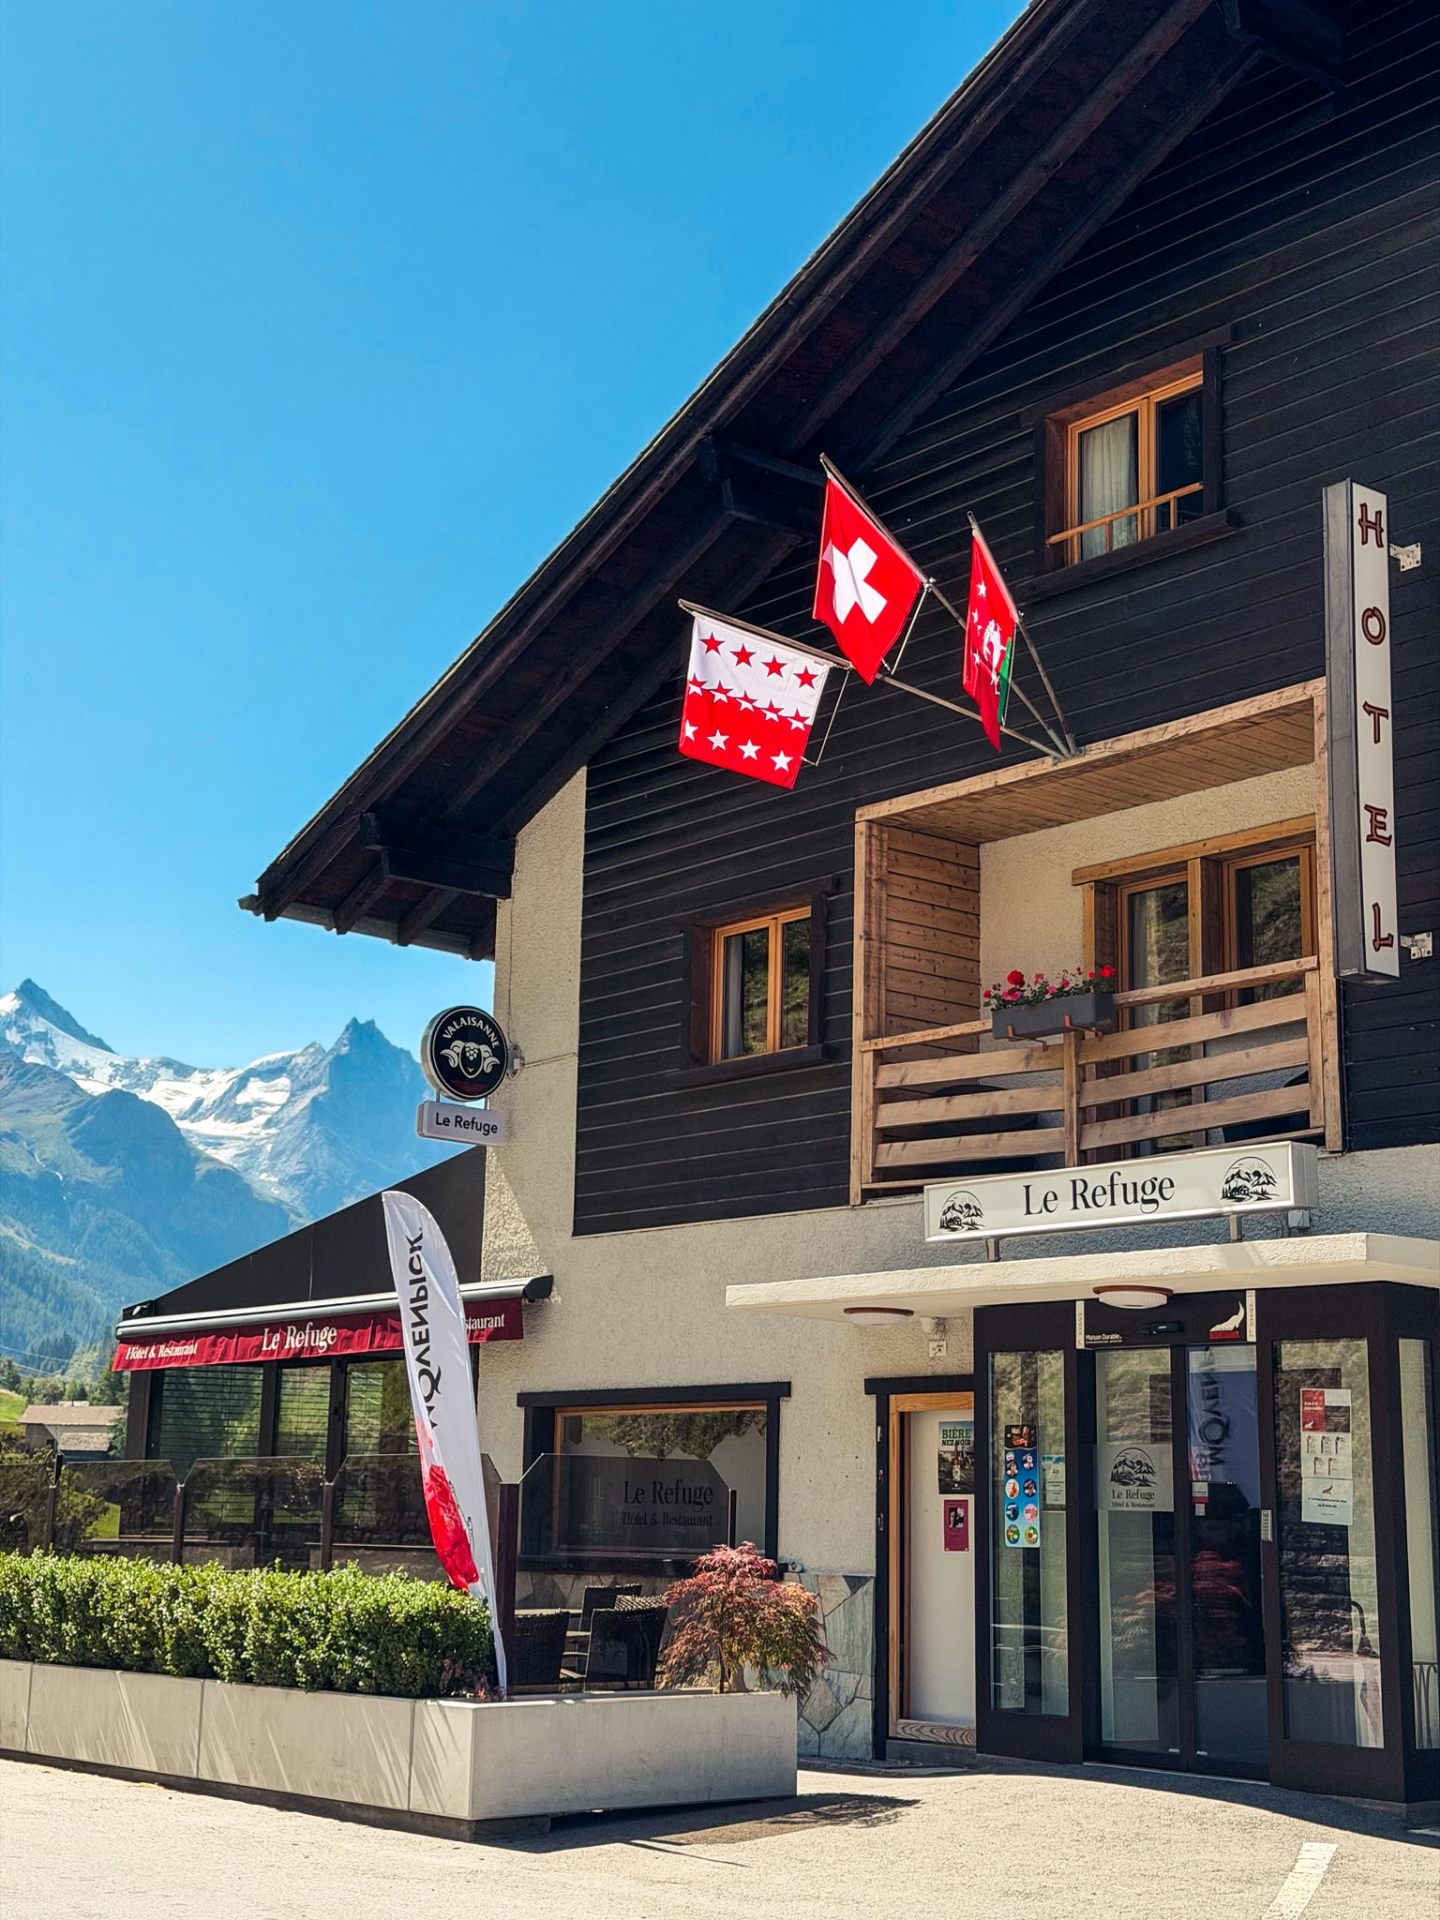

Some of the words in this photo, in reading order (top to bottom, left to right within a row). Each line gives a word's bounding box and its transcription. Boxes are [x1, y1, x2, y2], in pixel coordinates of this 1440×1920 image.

[1358, 502, 1396, 952] HOTEL
[442, 1016, 500, 1049] VALAISANNE
[435, 1112, 451, 1127] Le
[454, 1115, 499, 1136] Refuge
[1022, 1184, 1058, 1215] Le
[1069, 1170, 1175, 1214] Refuge
[464, 1313, 505, 1330] staurant
[148, 1345, 157, 1359] &
[158, 1342, 198, 1358] Restaurant
[262, 1327, 280, 1351] Le
[284, 1321, 338, 1353] Refuge
[623, 1481, 645, 1505] Le
[652, 1479, 714, 1512] Refuge
[1112, 1489, 1123, 1499] Le
[1126, 1489, 1155, 1502] Refuge
[662, 1511, 712, 1527] Restaurant
